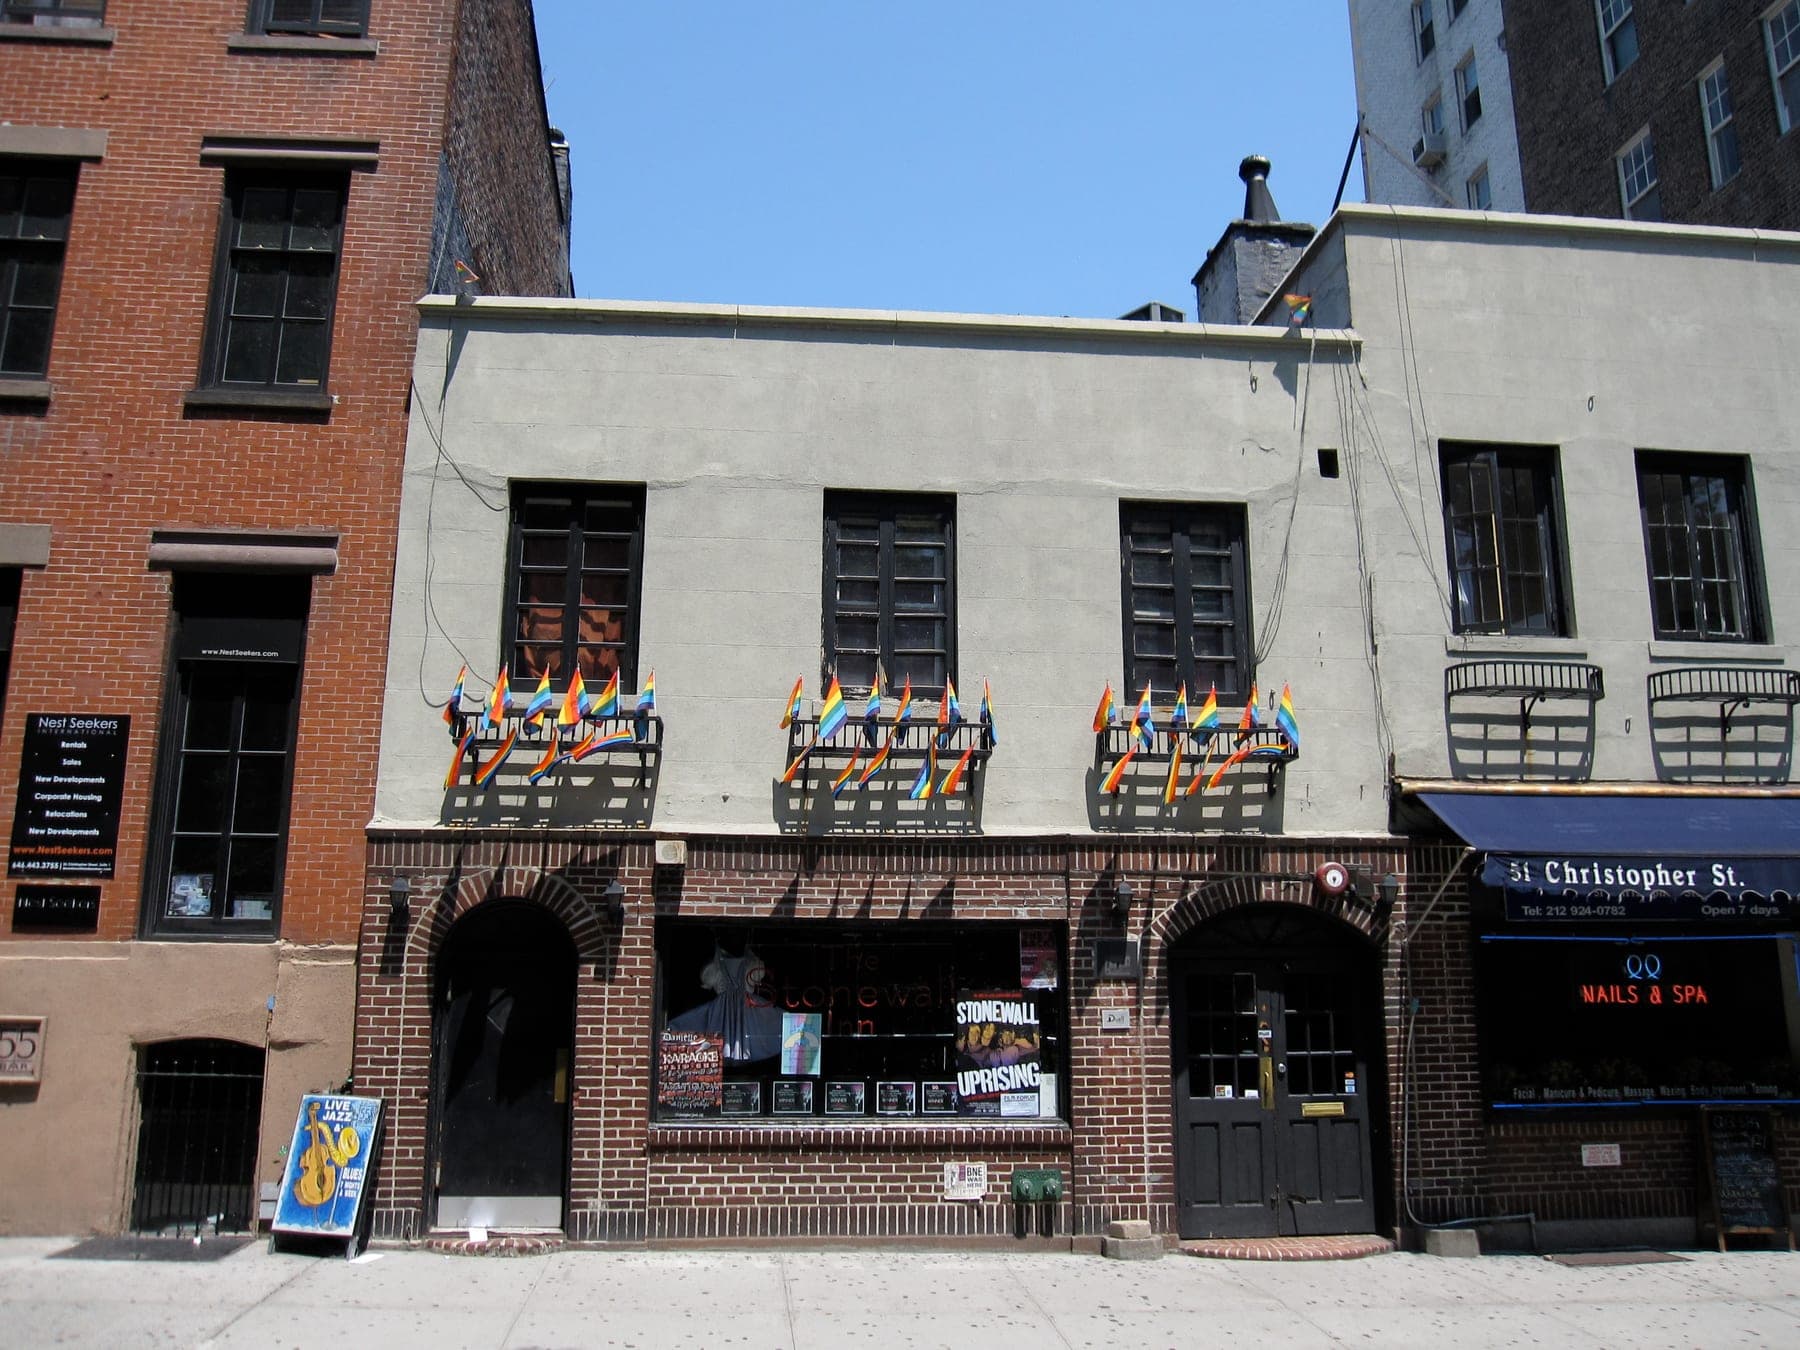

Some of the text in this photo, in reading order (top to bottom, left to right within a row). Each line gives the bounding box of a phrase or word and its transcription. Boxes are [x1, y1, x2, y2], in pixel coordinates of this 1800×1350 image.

[38, 717, 118, 729] Nest Seekers
[61, 741, 87, 749] Rentals
[53, 776, 105, 784] Developments
[34, 793, 102, 802] Corporate Housing
[45, 810, 87, 818] Relocations
[47, 828, 100, 837] Developments
[13, 847, 113, 855] www.NestSeekers.com
[1510, 861, 1745, 890] 51 Christopher St.
[1521, 906, 1626, 916] Tel: 212 924-0782
[1701, 904, 1780, 917] Open 7 days
[1626, 954, 1661, 980] QQ
[1582, 984, 1709, 1005] NAILS & SPA
[956, 1000, 1039, 1025] STONEWALL
[662, 1051, 719, 1064] KARAOKE
[957, 1062, 1041, 1097] UPRISING
[325, 1100, 350, 1110] LIVE
[322, 1111, 352, 1121] JAZZ
[343, 1167, 363, 1180] BLUES
[967, 1166, 983, 1177] BNE
